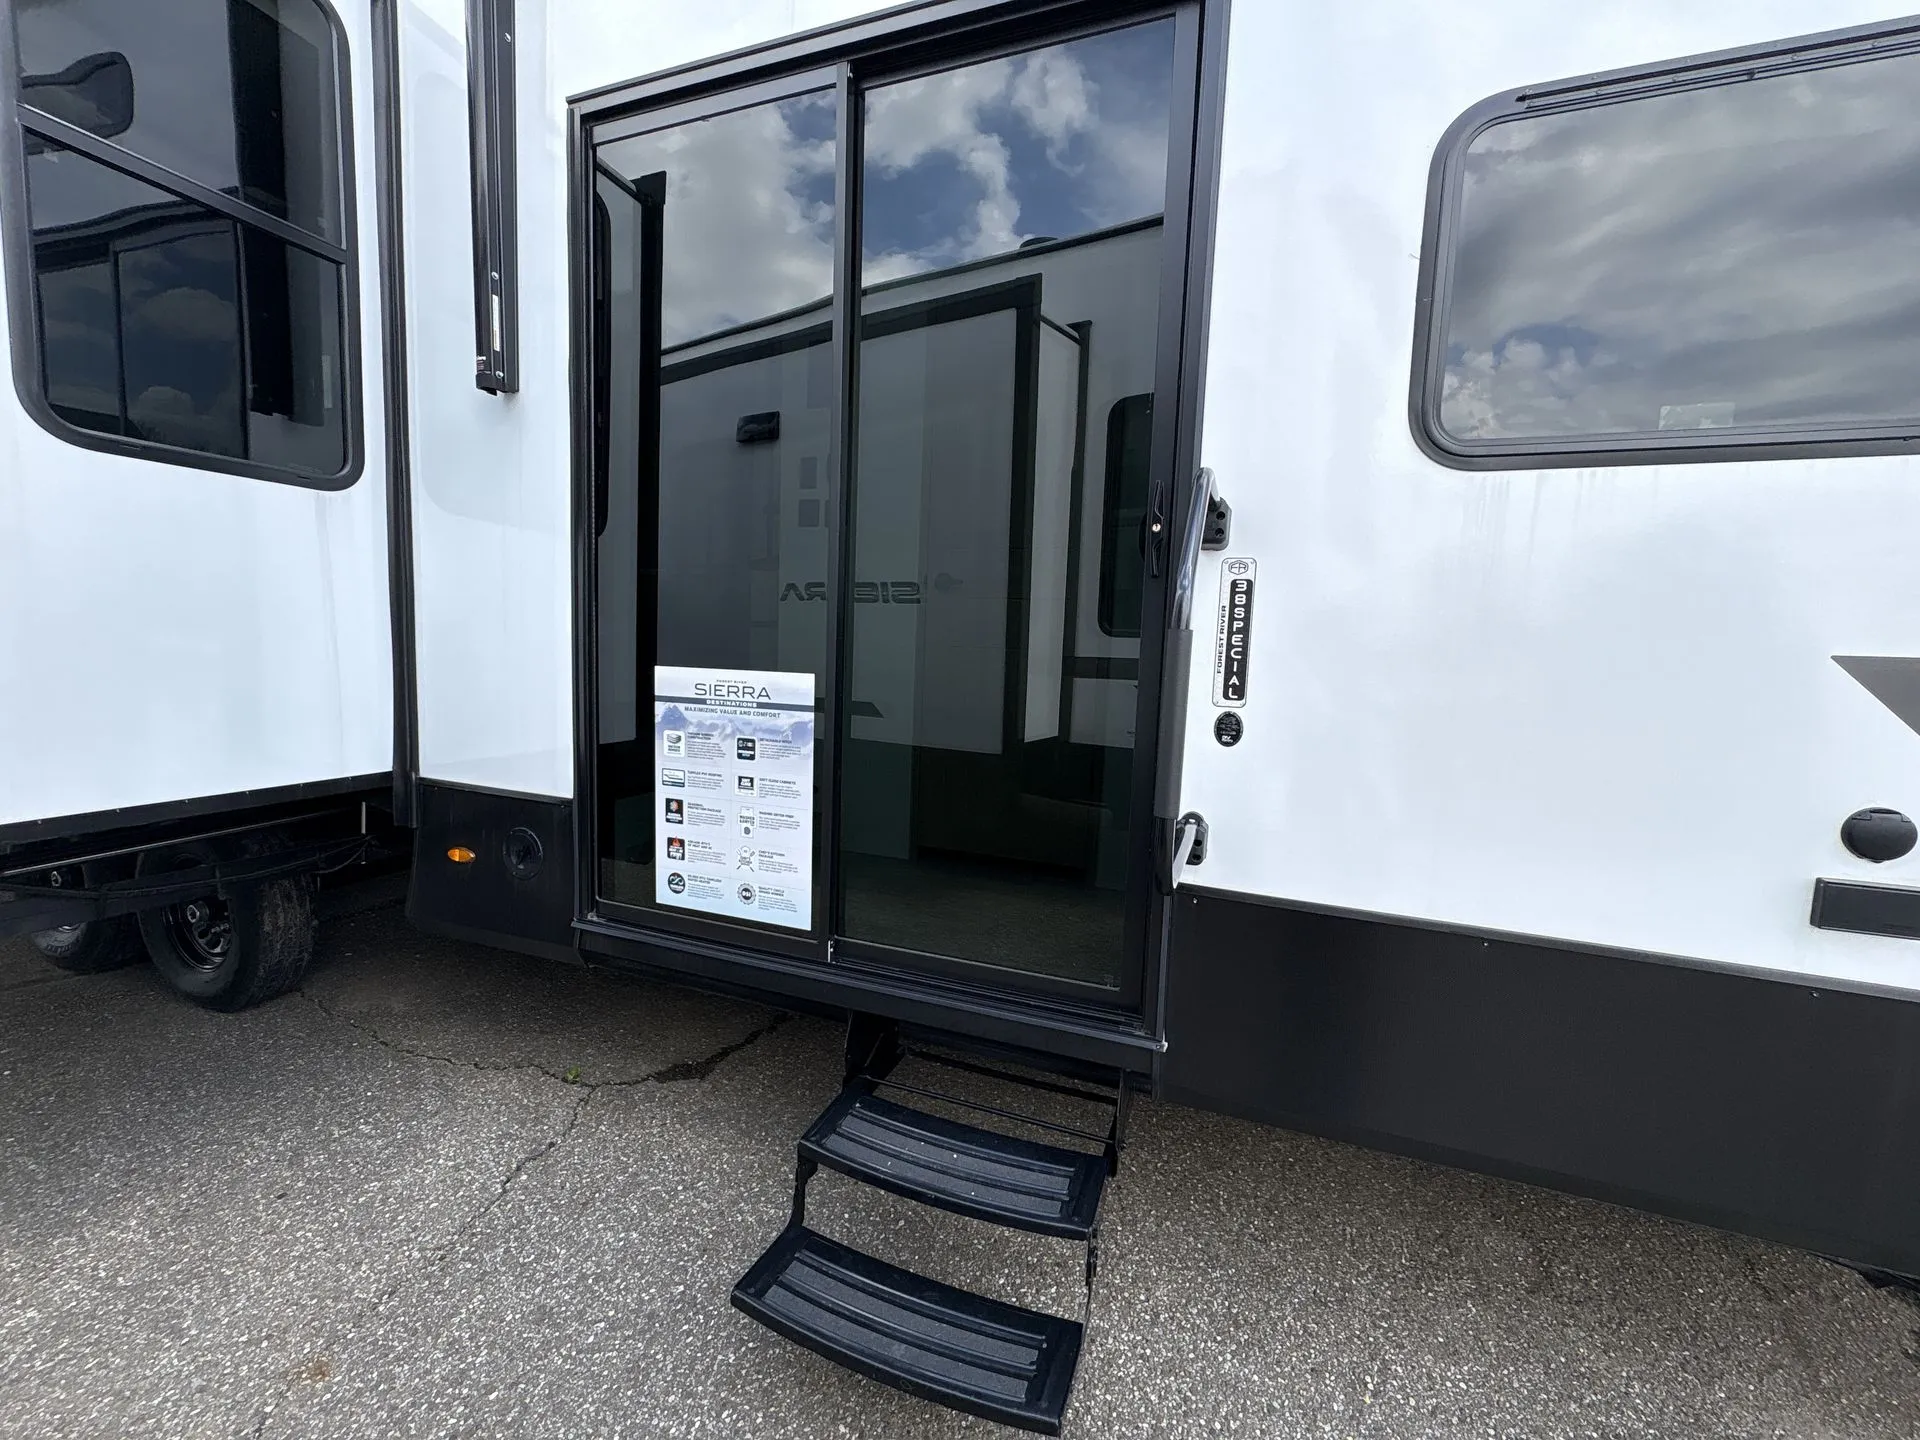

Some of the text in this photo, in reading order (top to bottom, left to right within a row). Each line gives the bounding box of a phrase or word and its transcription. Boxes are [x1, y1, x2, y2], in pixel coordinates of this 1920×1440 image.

[1216, 605, 1227, 674] FOREST RIVER
[694, 683, 771, 700] SIERRA
[706, 699, 758, 708] DESTINATIONS
[684, 706, 718, 714] MAXIMIZING
[753, 711, 781, 719] COMFORT
